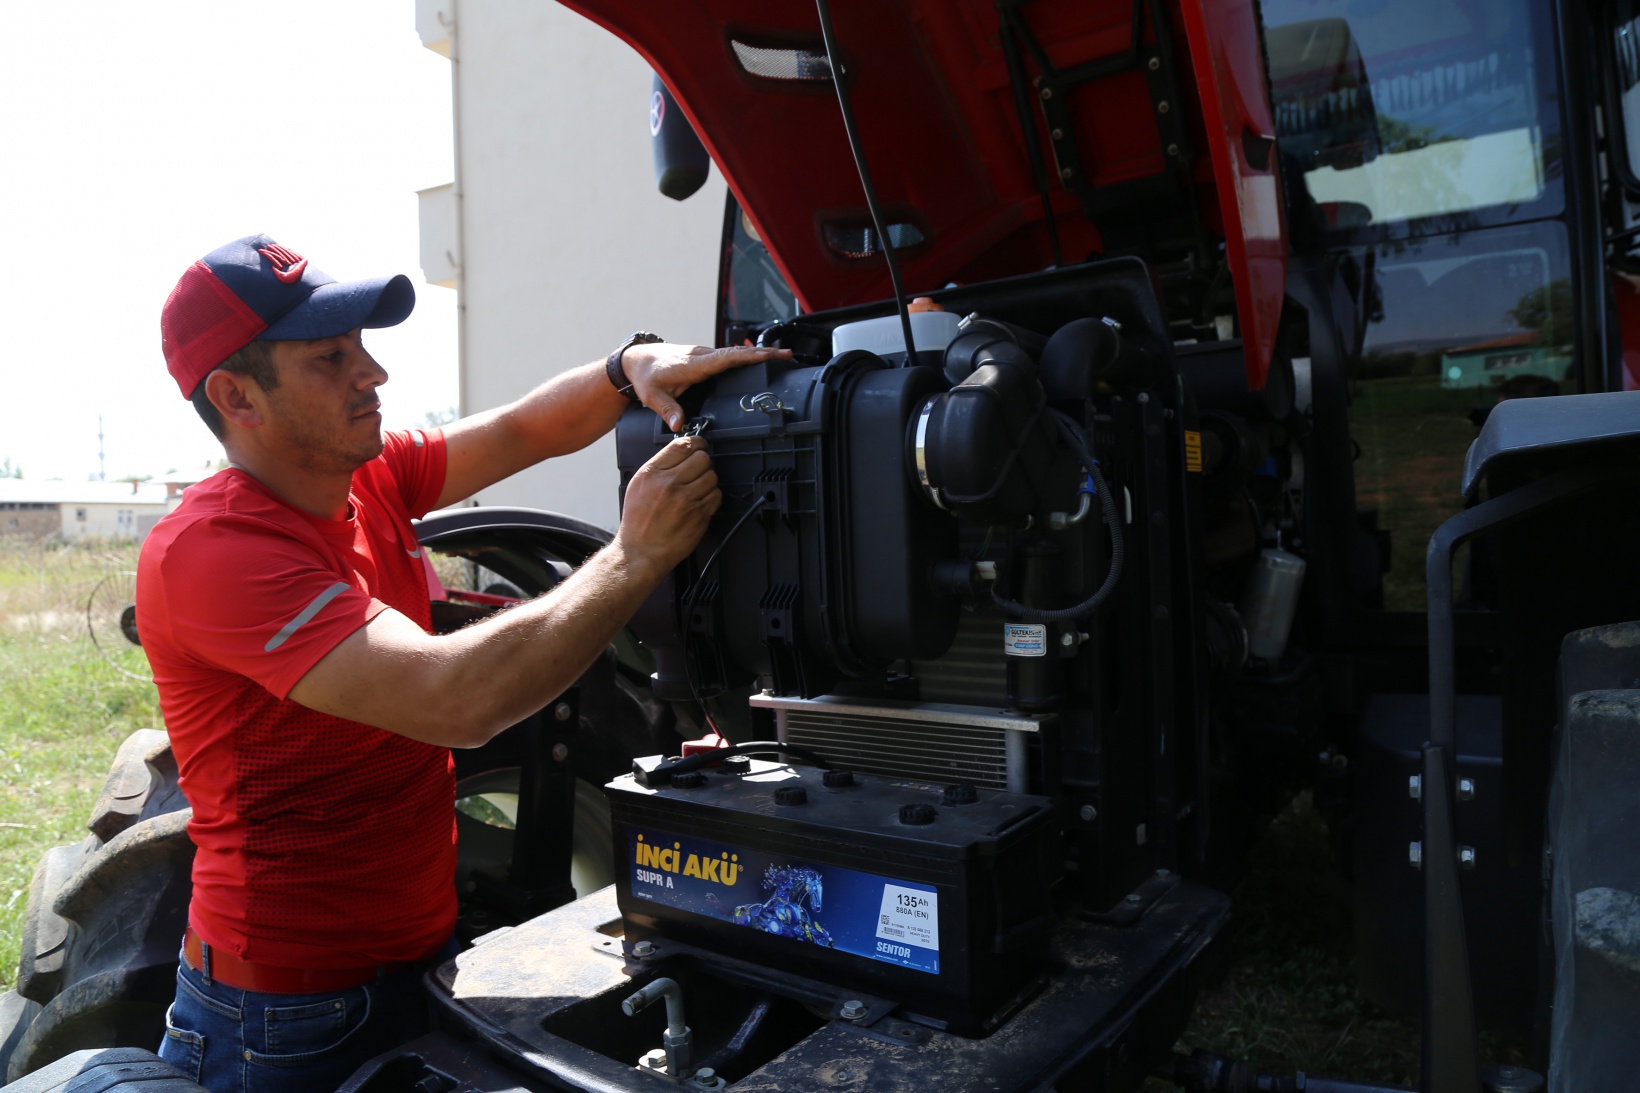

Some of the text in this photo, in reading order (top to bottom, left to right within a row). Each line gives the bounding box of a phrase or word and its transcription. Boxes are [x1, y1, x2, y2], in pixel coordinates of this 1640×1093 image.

[635, 833, 681, 874] İNCİ
[636, 869, 674, 889] SUPR A
[895, 906, 929, 920] 880A (EN)
[876, 941, 911, 959] SENTOR
